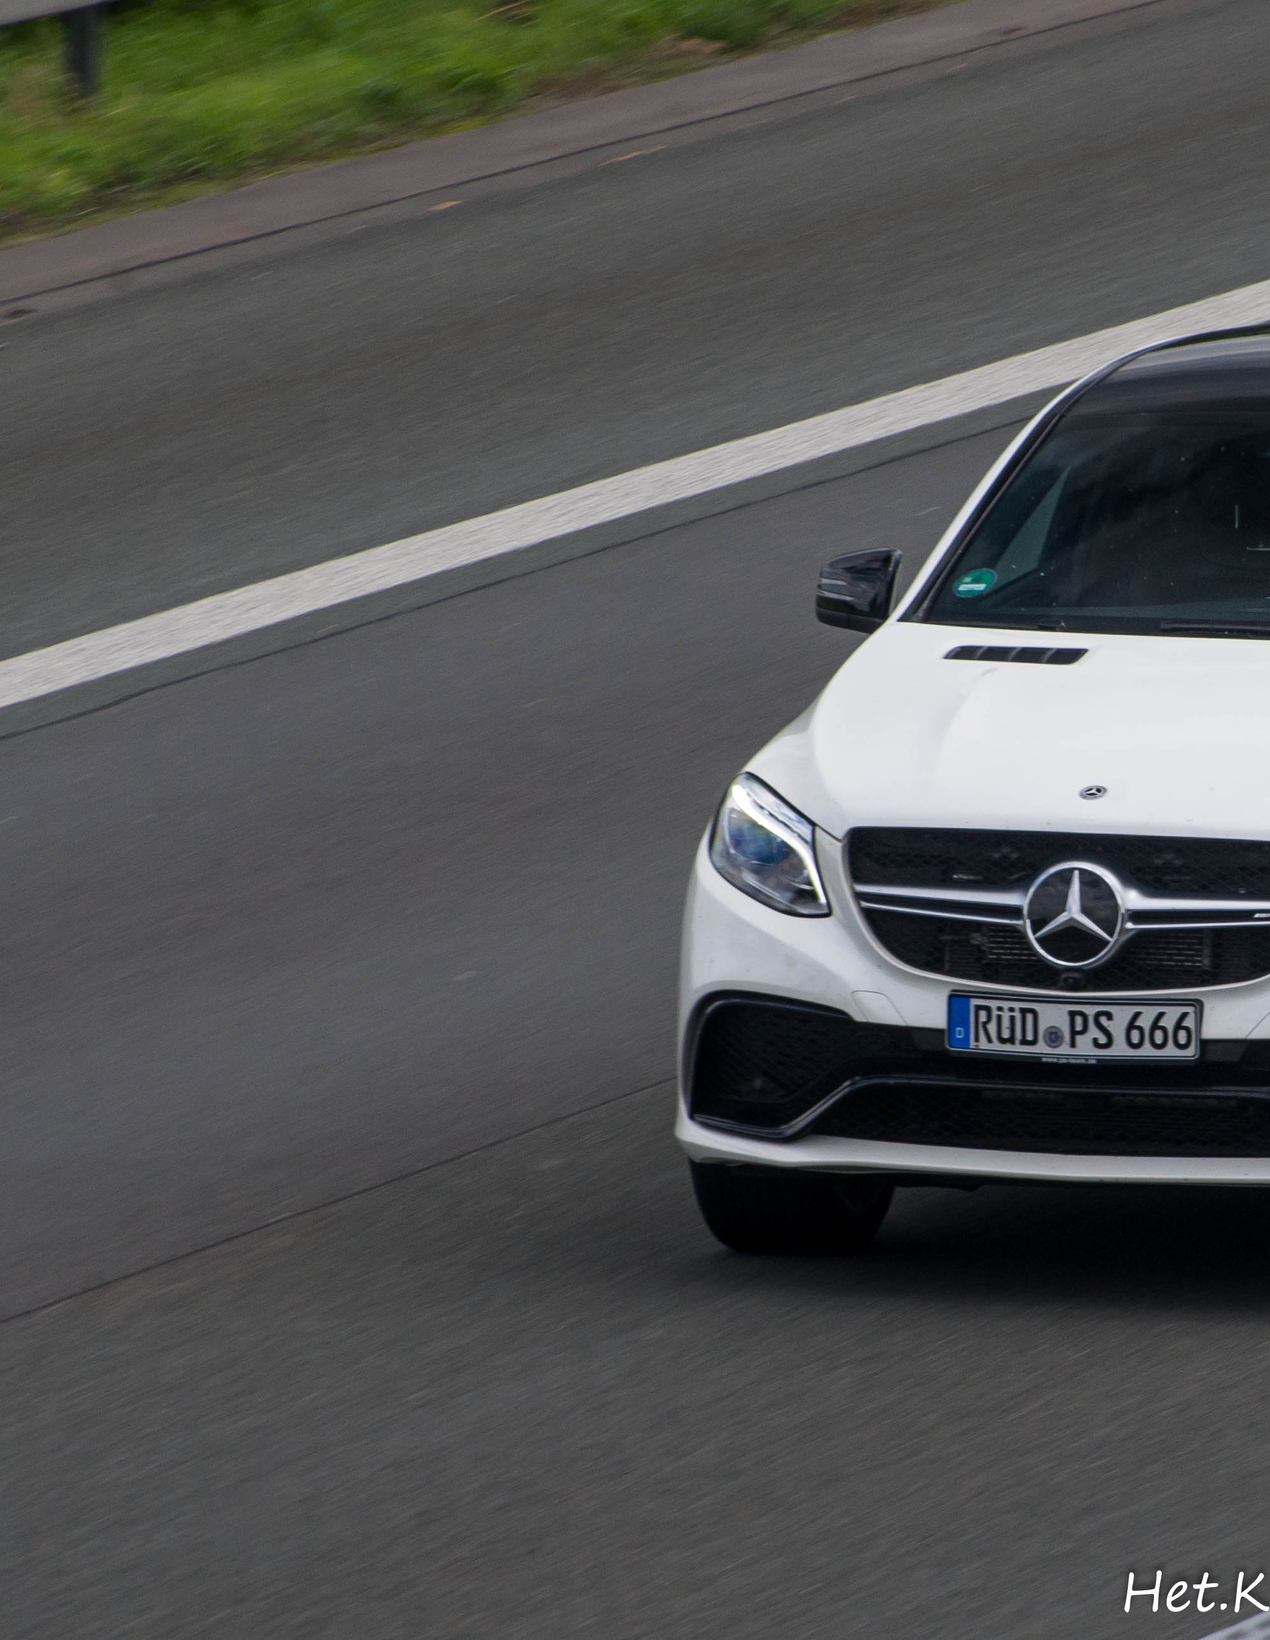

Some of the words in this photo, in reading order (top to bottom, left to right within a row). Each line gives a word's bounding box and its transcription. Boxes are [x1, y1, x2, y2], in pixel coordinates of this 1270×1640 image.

[956, 1027, 964, 1038] D
[1068, 1009, 1114, 1050] PS
[1125, 1011, 1193, 1051] 666
